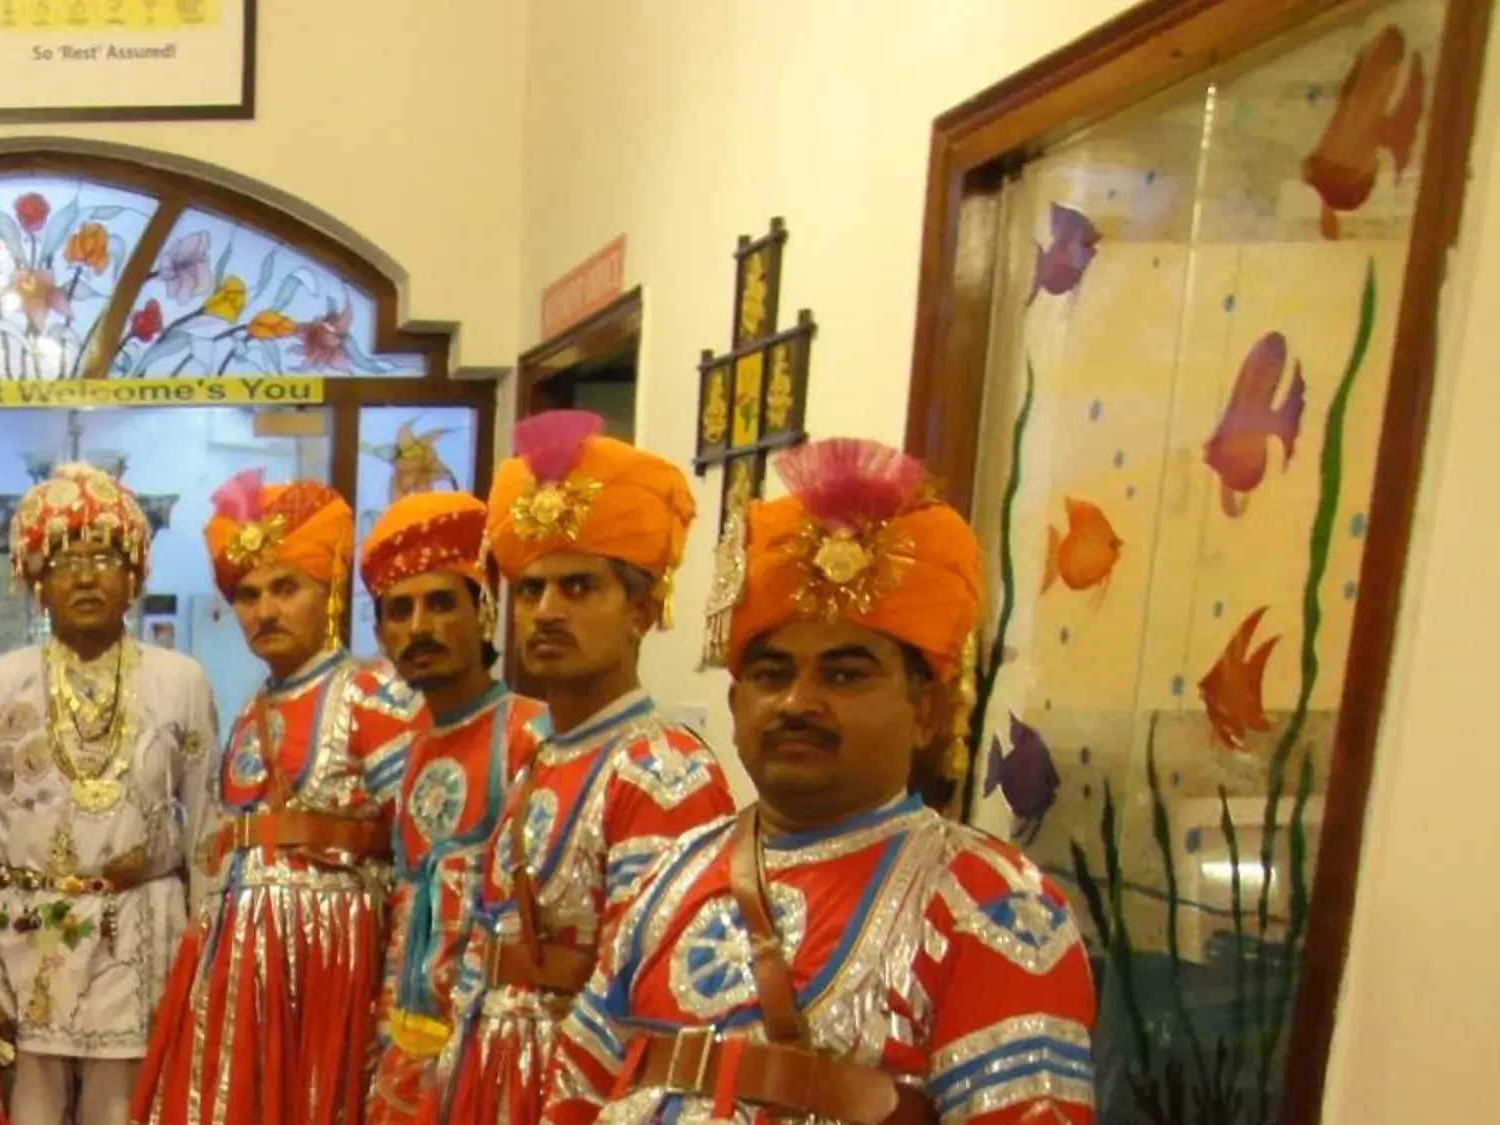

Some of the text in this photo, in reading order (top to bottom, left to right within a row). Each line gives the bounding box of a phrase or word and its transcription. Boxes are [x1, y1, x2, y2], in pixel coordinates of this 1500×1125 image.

[31, 45, 53, 60] So
[16, 379, 226, 403] Welcome's
[240, 379, 312, 400] You
